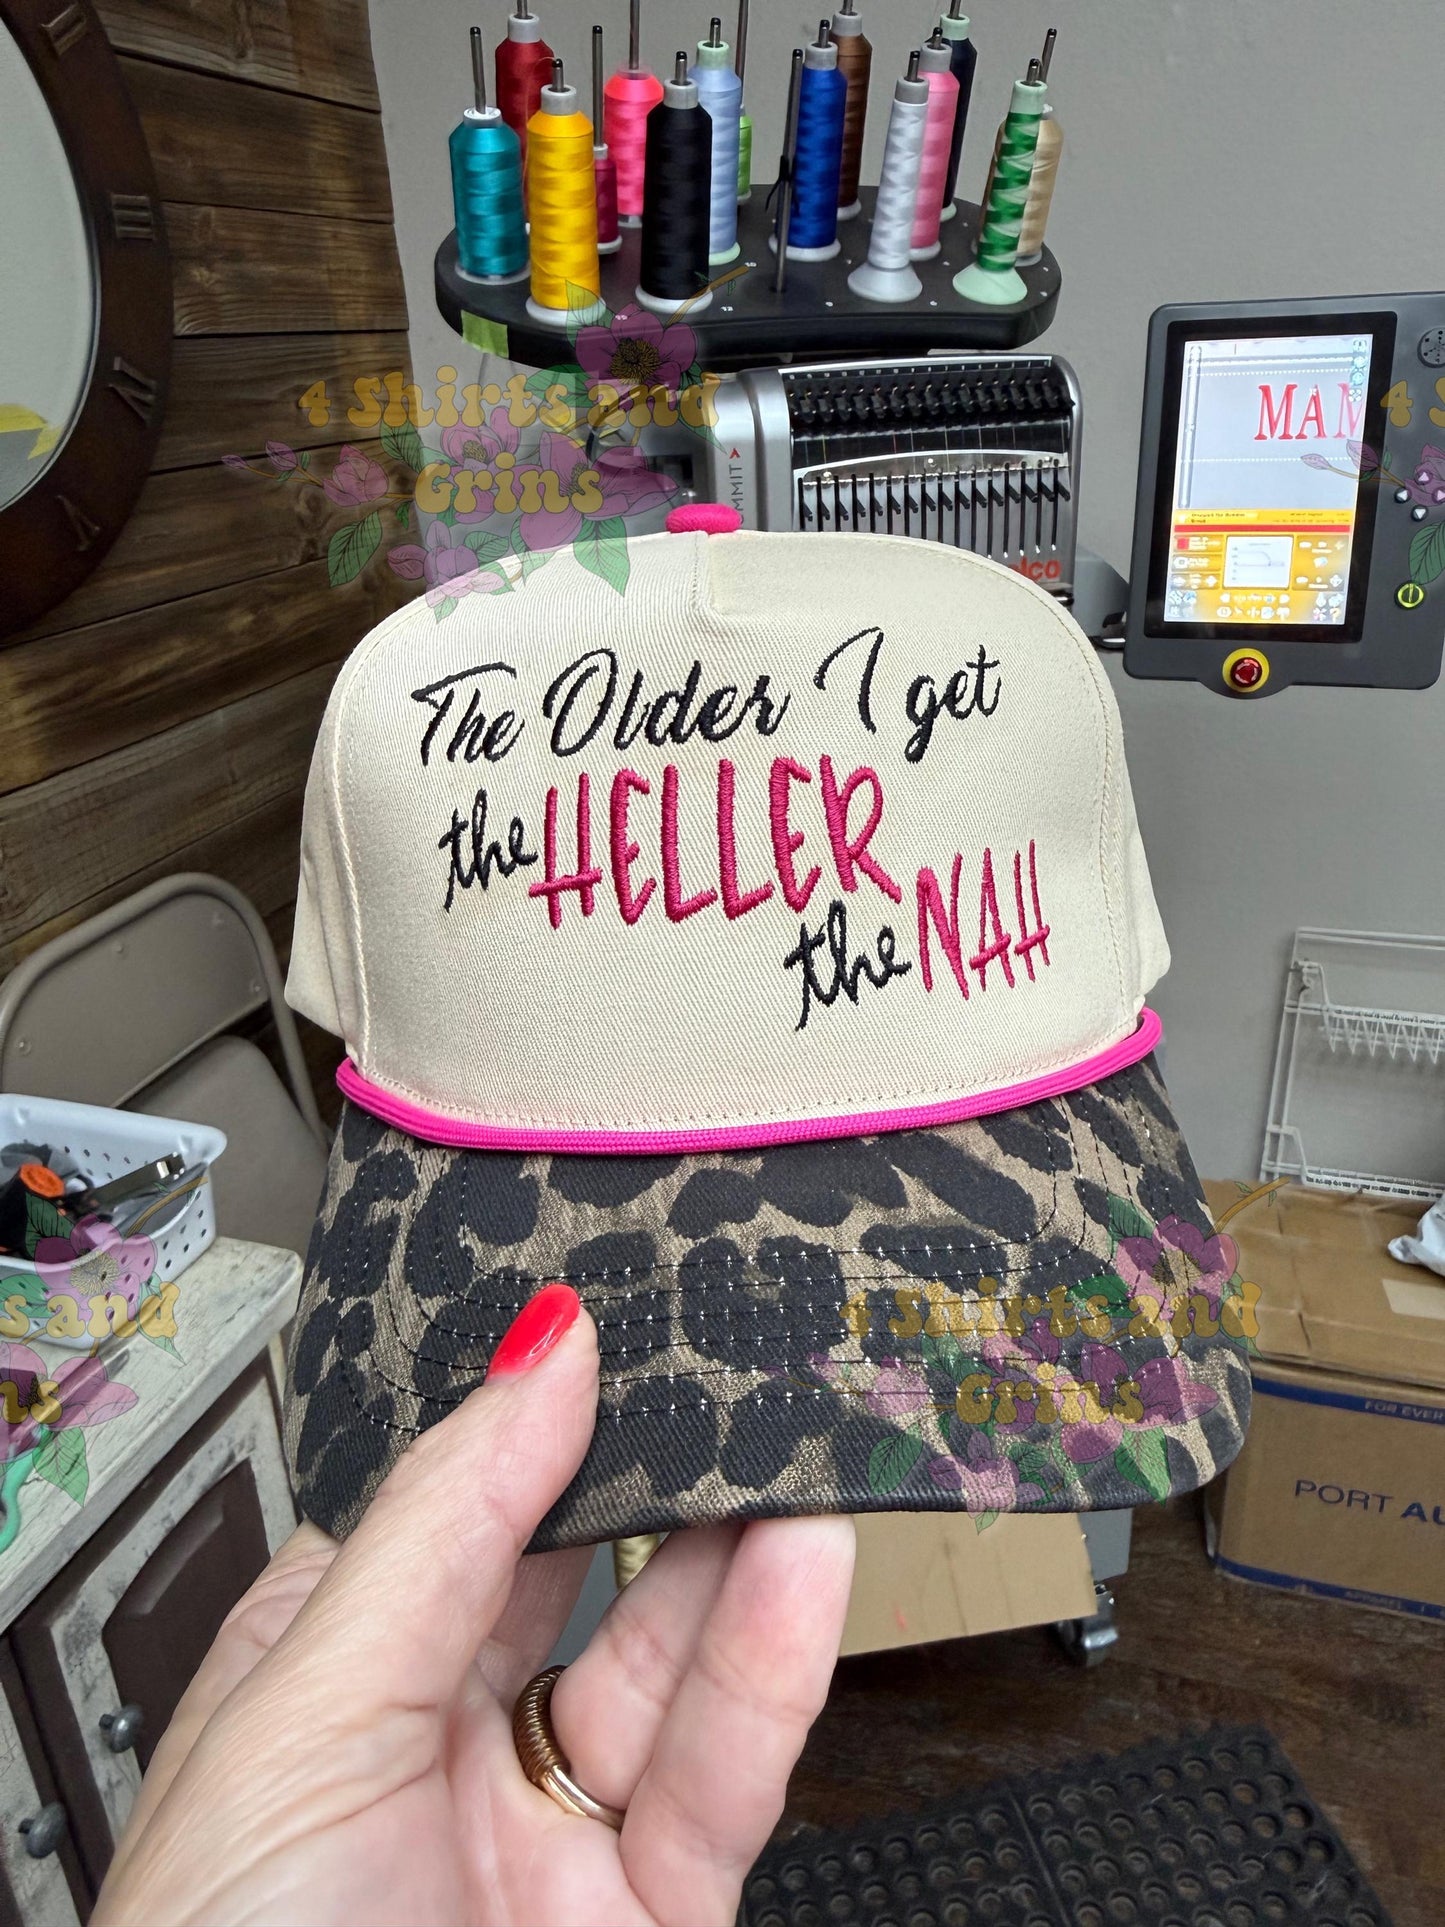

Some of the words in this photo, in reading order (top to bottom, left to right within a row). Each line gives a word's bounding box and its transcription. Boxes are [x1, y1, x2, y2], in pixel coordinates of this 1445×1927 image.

[728, 464, 744, 525] MMIT
[411, 661, 526, 766] The
[543, 648, 791, 757] Older
[813, 626, 884, 733] I
[905, 645, 1002, 763] get
[439, 788, 538, 912] the
[528, 754, 902, 929] HELLER
[783, 900, 912, 1031] the
[915, 839, 1050, 1000] NAH
[1364, 1401, 1398, 1413] FOR
[1294, 1479, 1394, 1513] PORT
